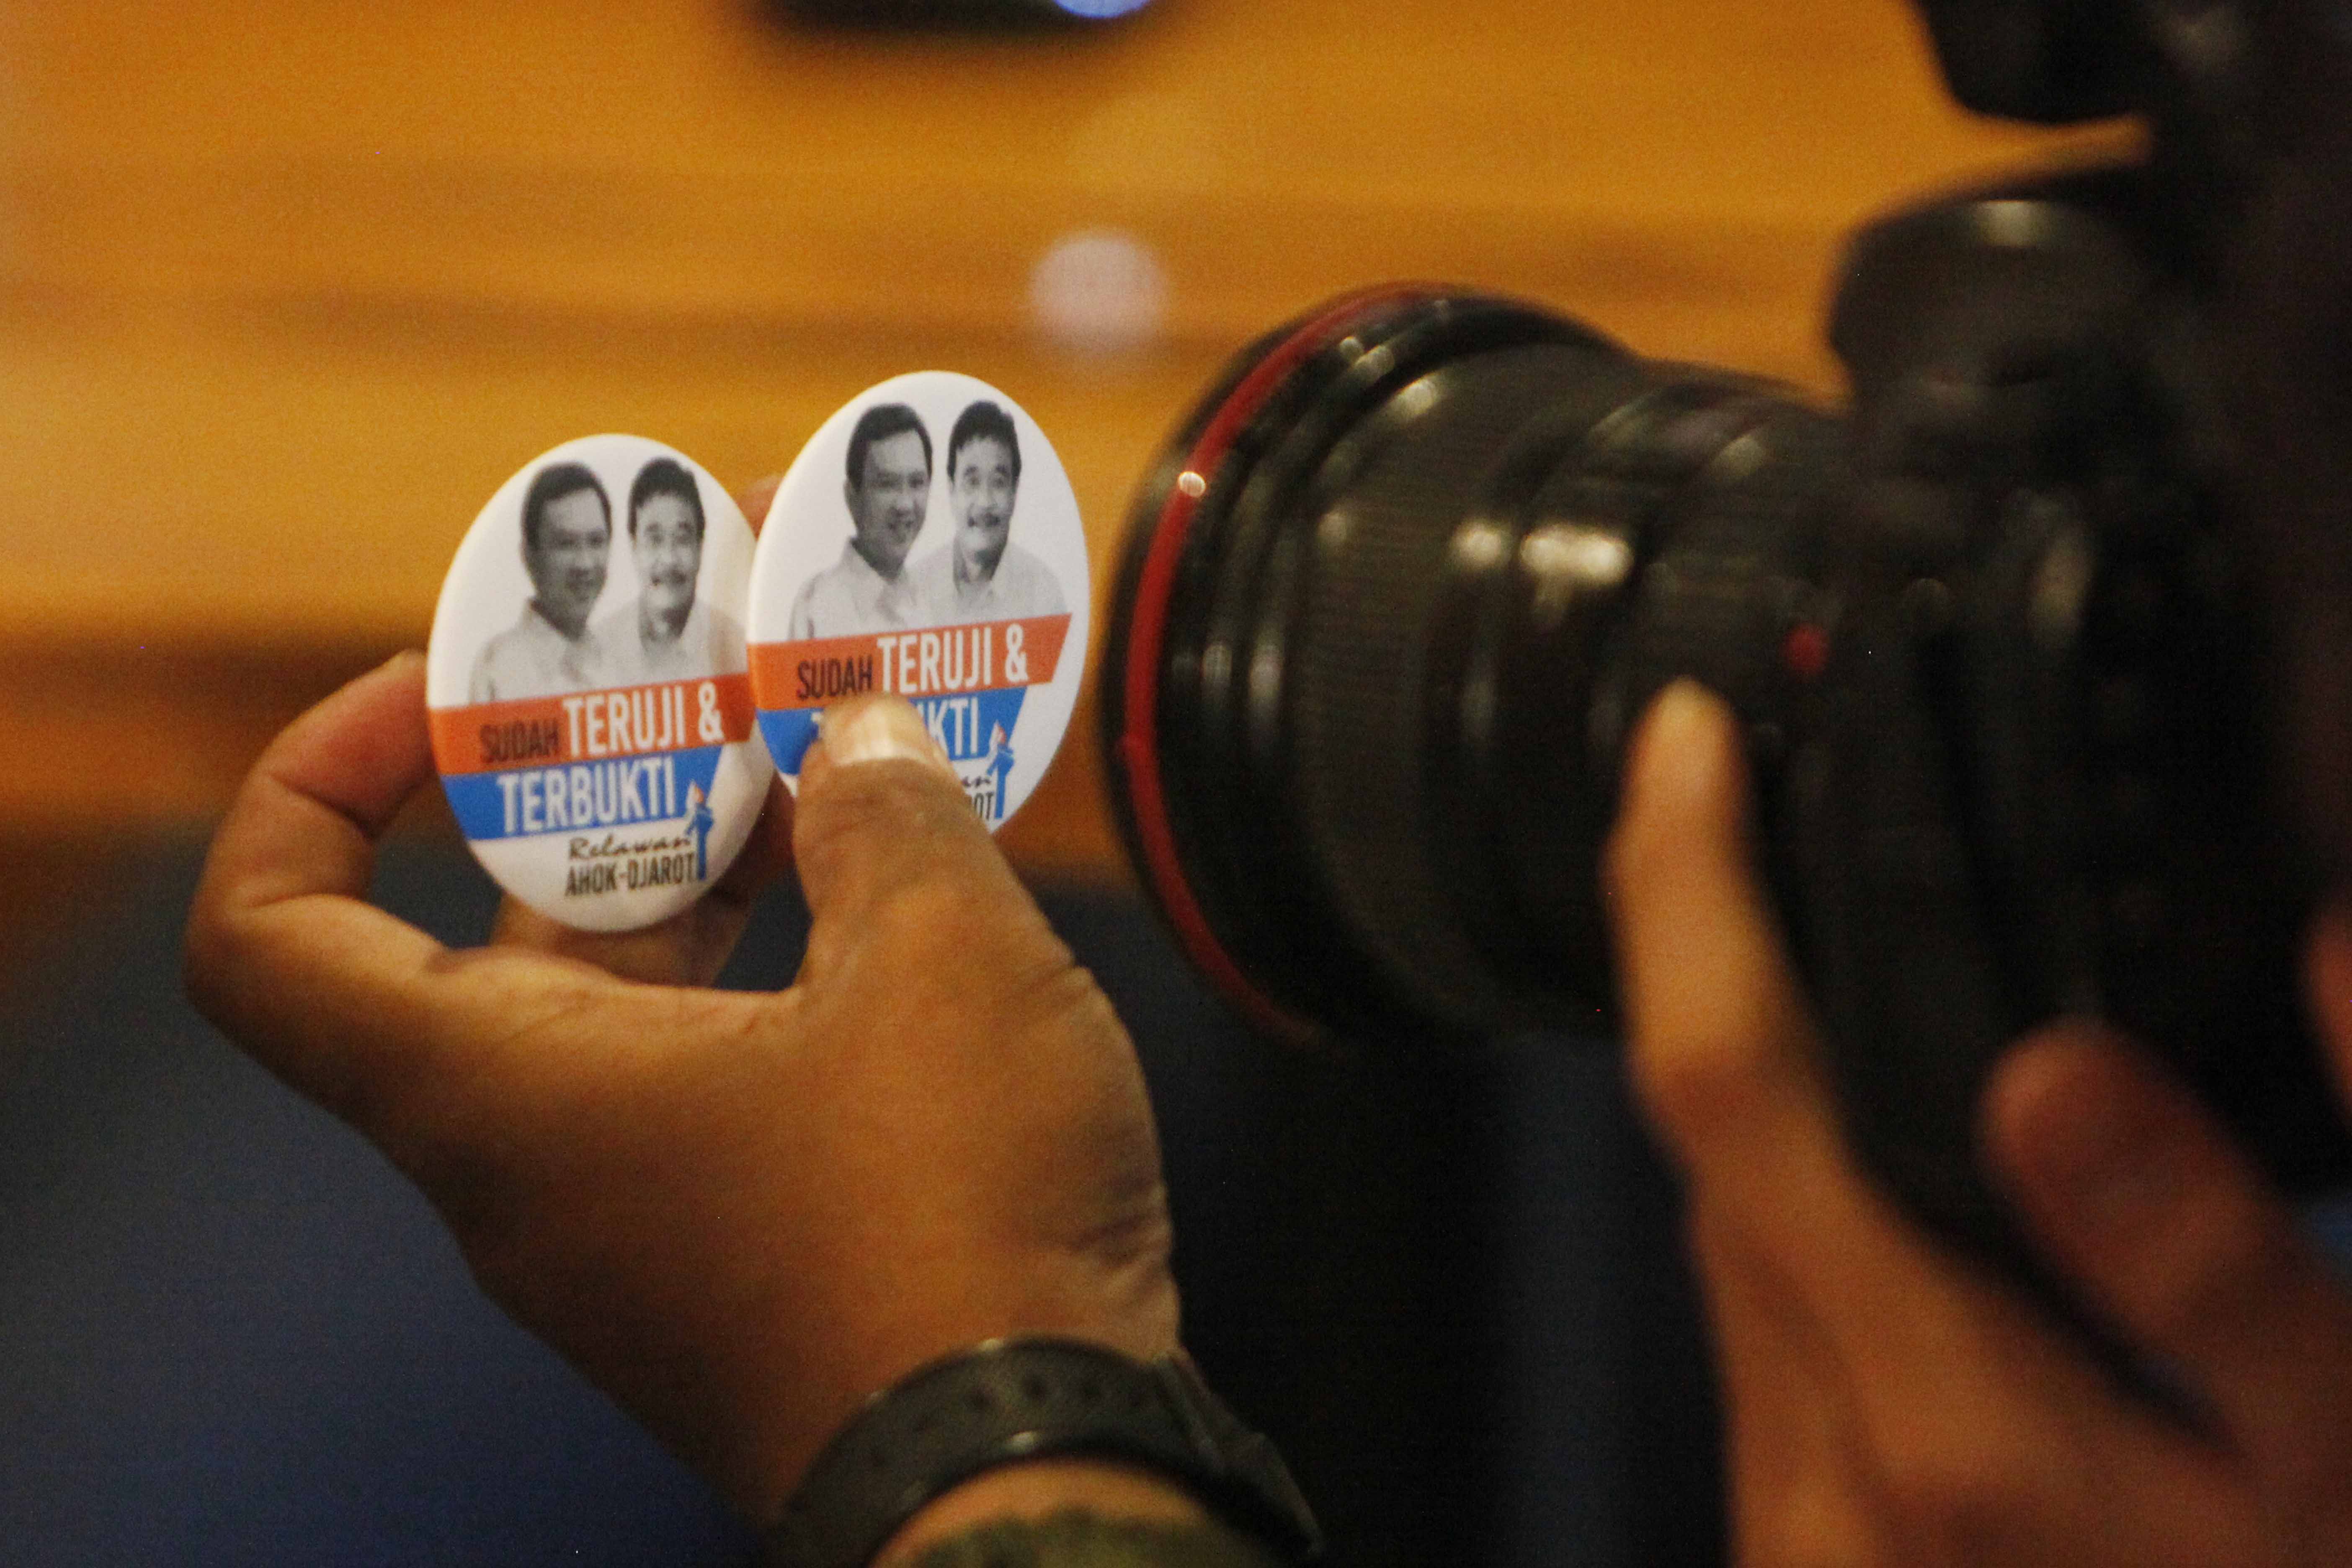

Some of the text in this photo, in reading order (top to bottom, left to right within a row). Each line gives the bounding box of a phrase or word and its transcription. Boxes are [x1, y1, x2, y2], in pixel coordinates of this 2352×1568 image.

[798, 624, 1028, 699] SUDAH TERUJI &
[481, 681, 724, 761] SUDAH TERUJI &
[498, 758, 674, 832] TERBUKTI
[566, 853, 696, 896] AHOK-DJAROT
[570, 834, 690, 859] Relawan
